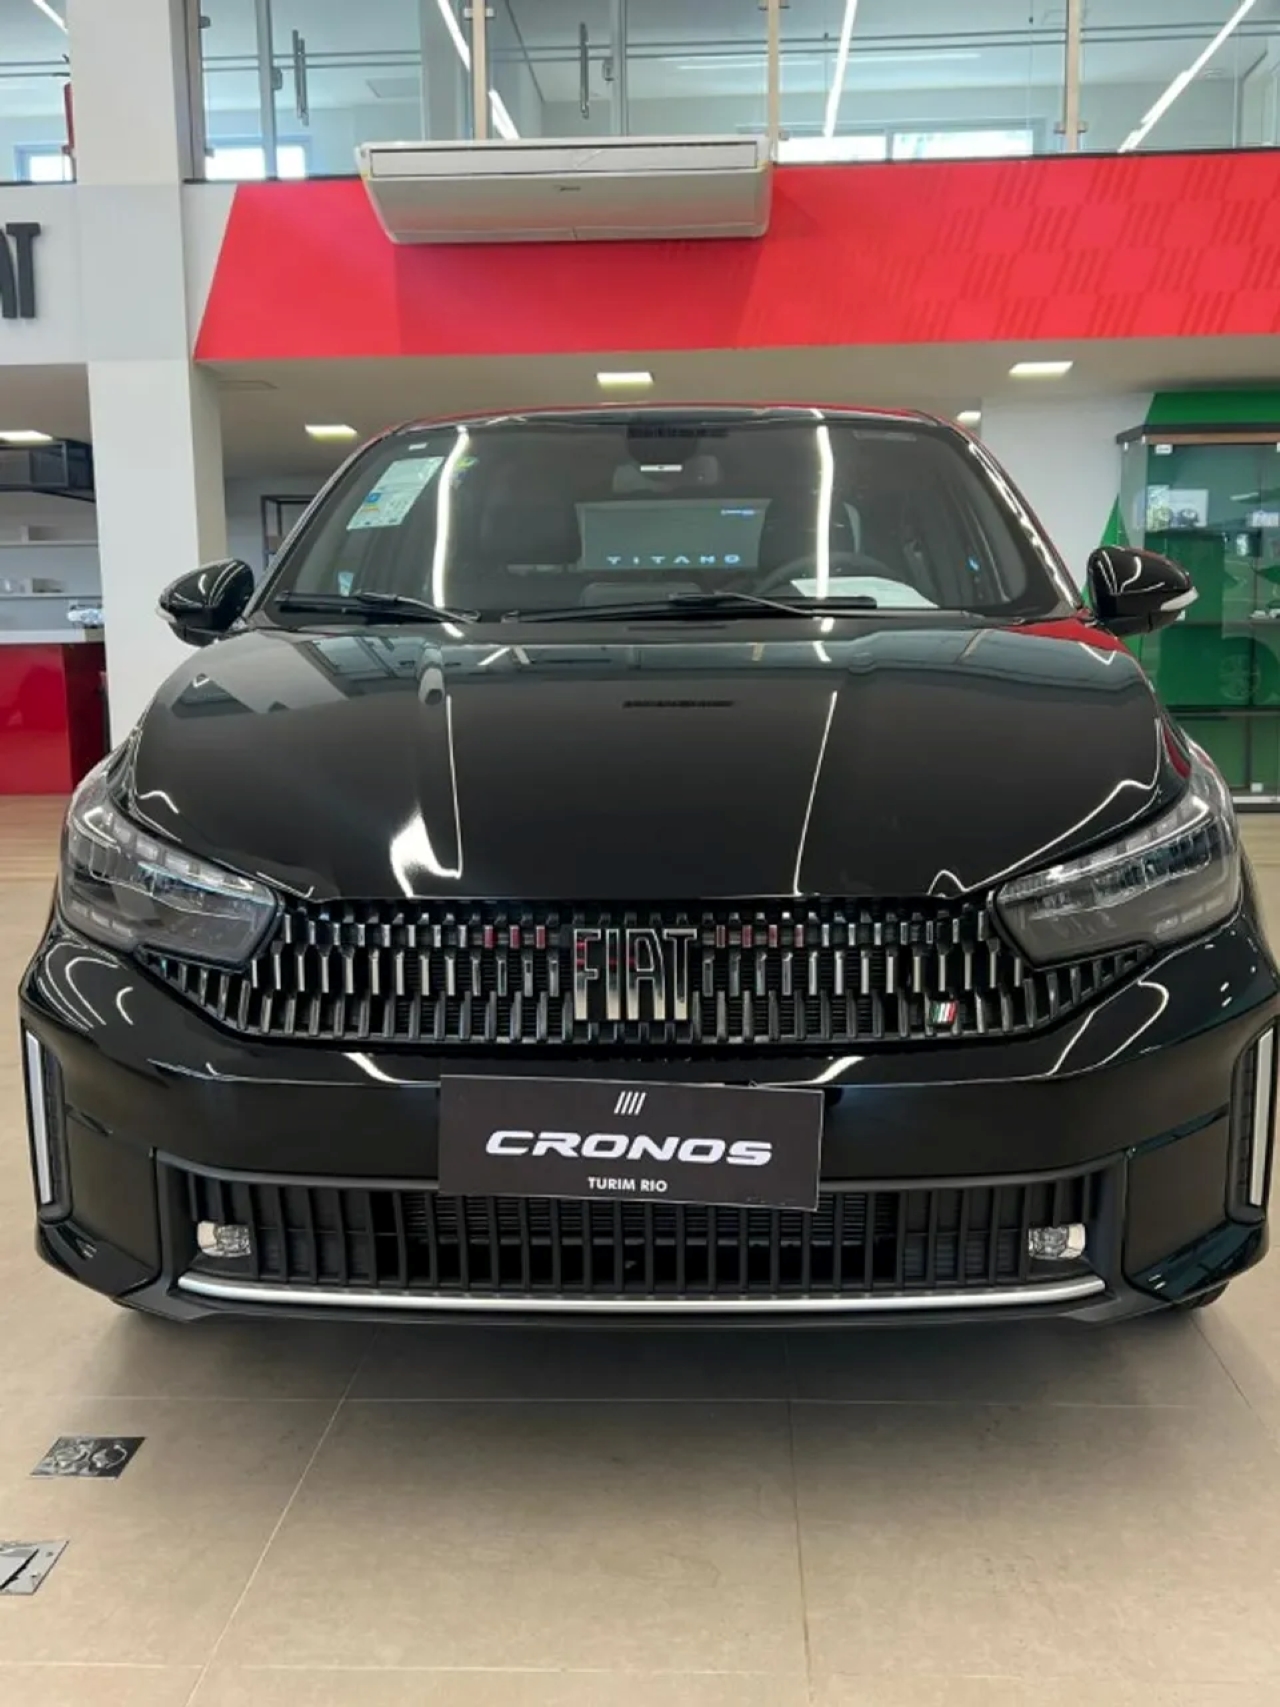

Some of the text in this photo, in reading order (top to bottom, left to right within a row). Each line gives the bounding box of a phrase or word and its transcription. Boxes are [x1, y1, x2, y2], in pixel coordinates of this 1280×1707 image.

[606, 554, 741, 565] TITANO
[574, 928, 697, 1020] FIAT
[485, 1130, 773, 1166] CRONOS
[588, 1177, 668, 1192] TURIM RIO
